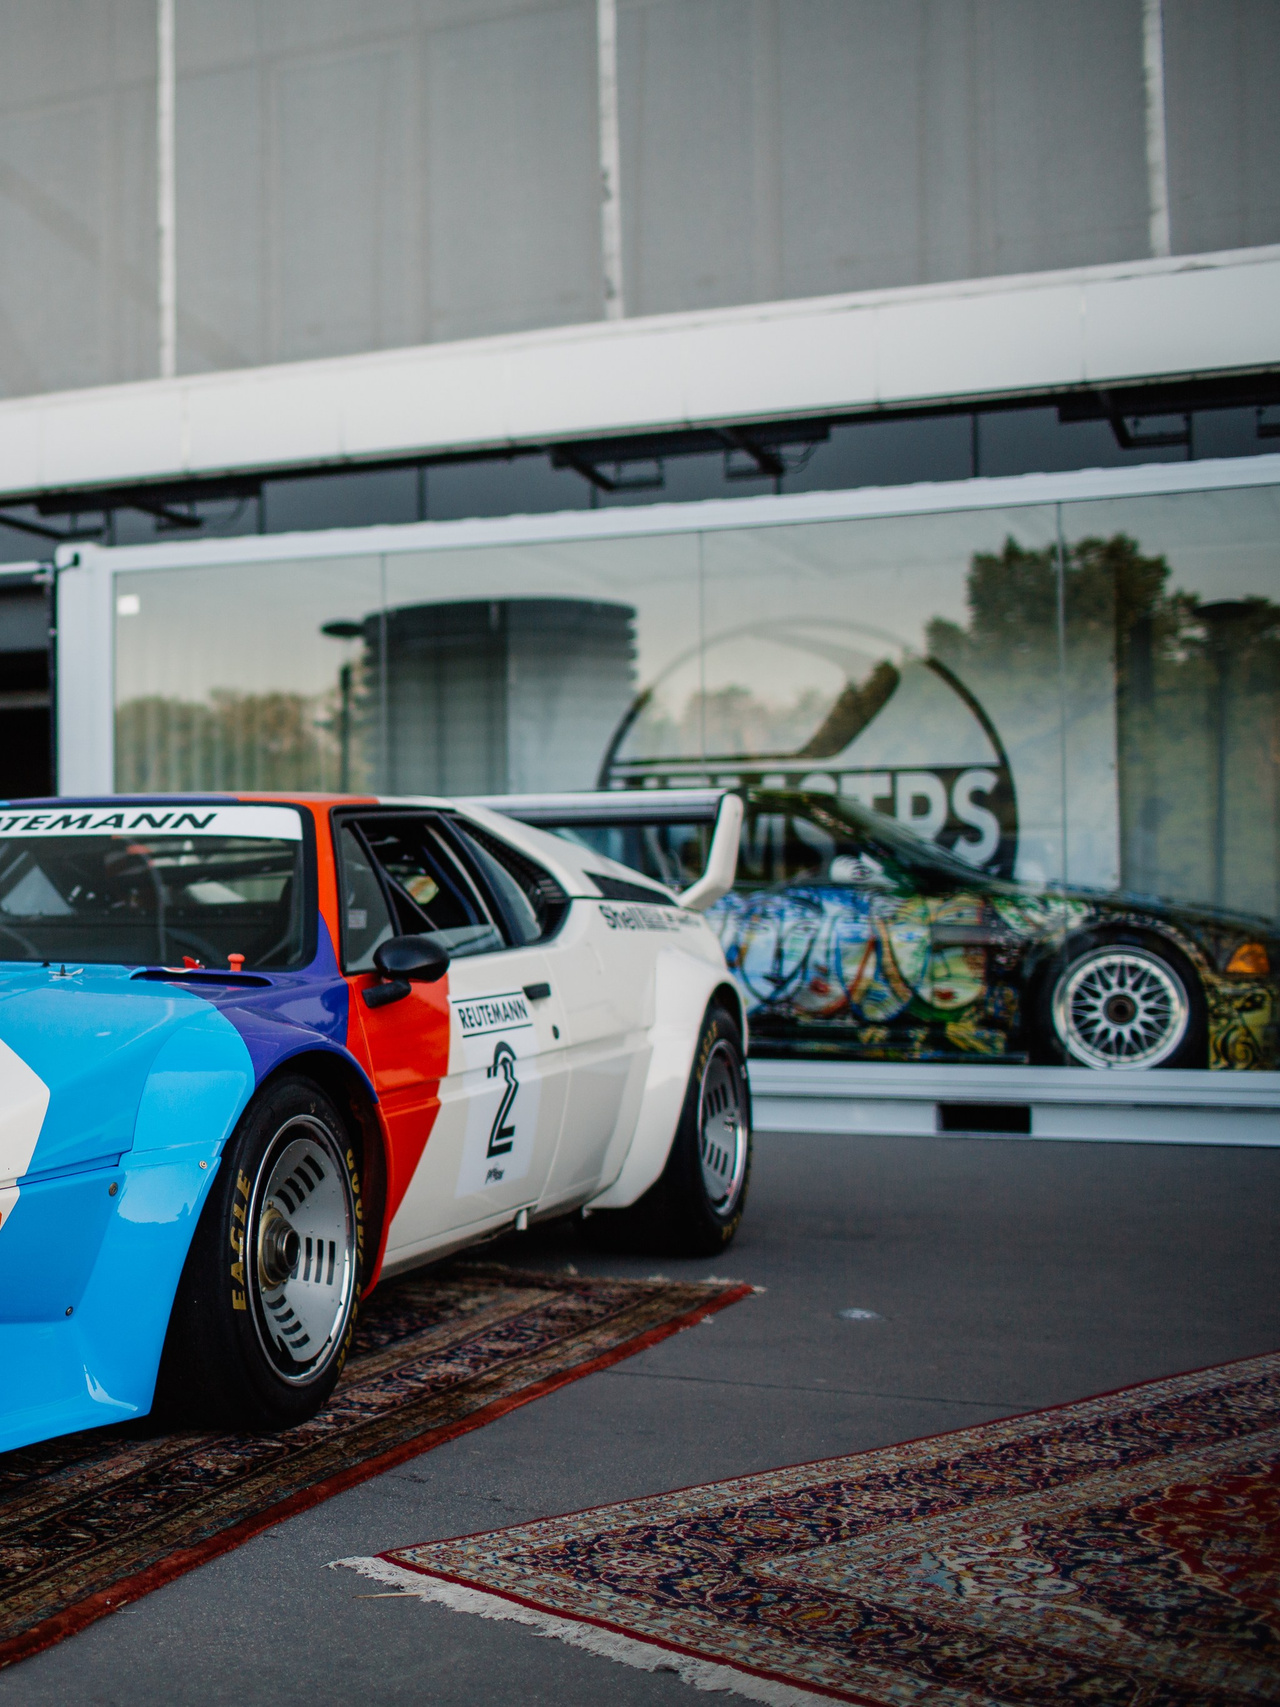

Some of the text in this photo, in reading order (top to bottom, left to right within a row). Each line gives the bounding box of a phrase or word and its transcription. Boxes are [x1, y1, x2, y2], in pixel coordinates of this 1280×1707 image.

[457, 998, 529, 1030] REUTEMANN
[486, 1040, 520, 1160] 2
[230, 1168, 251, 1311] EAGLE
